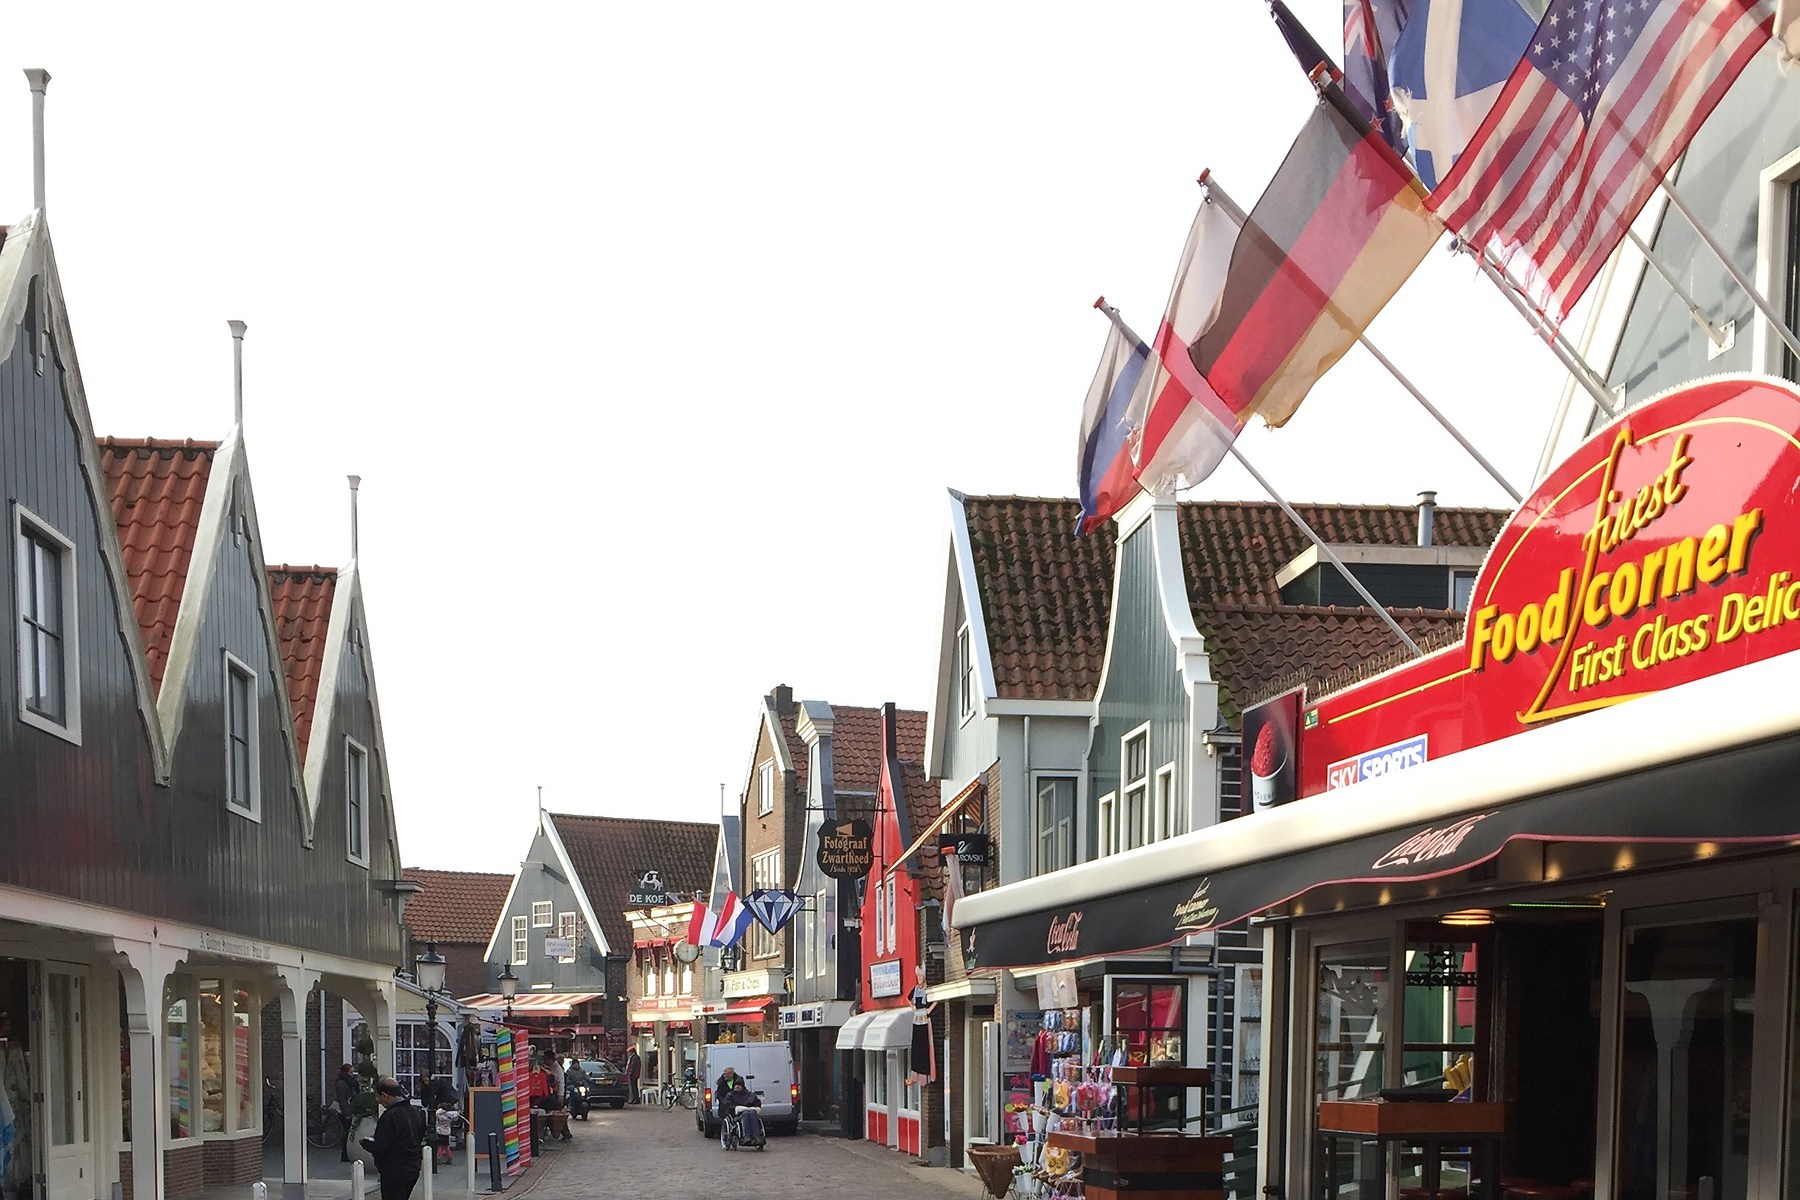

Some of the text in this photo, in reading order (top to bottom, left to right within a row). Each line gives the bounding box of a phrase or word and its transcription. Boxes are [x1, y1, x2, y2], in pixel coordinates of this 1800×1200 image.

[1582, 429, 1694, 553] finest
[1470, 507, 1764, 673] Food corner
[1568, 635, 1628, 692] First
[1631, 614, 1713, 671] Class
[822, 851, 869, 864] Zwarthoed
[823, 836, 867, 851] Fotograaf
[630, 894, 665, 904] DE KOE
[1047, 911, 1083, 954] Coca-Cola
